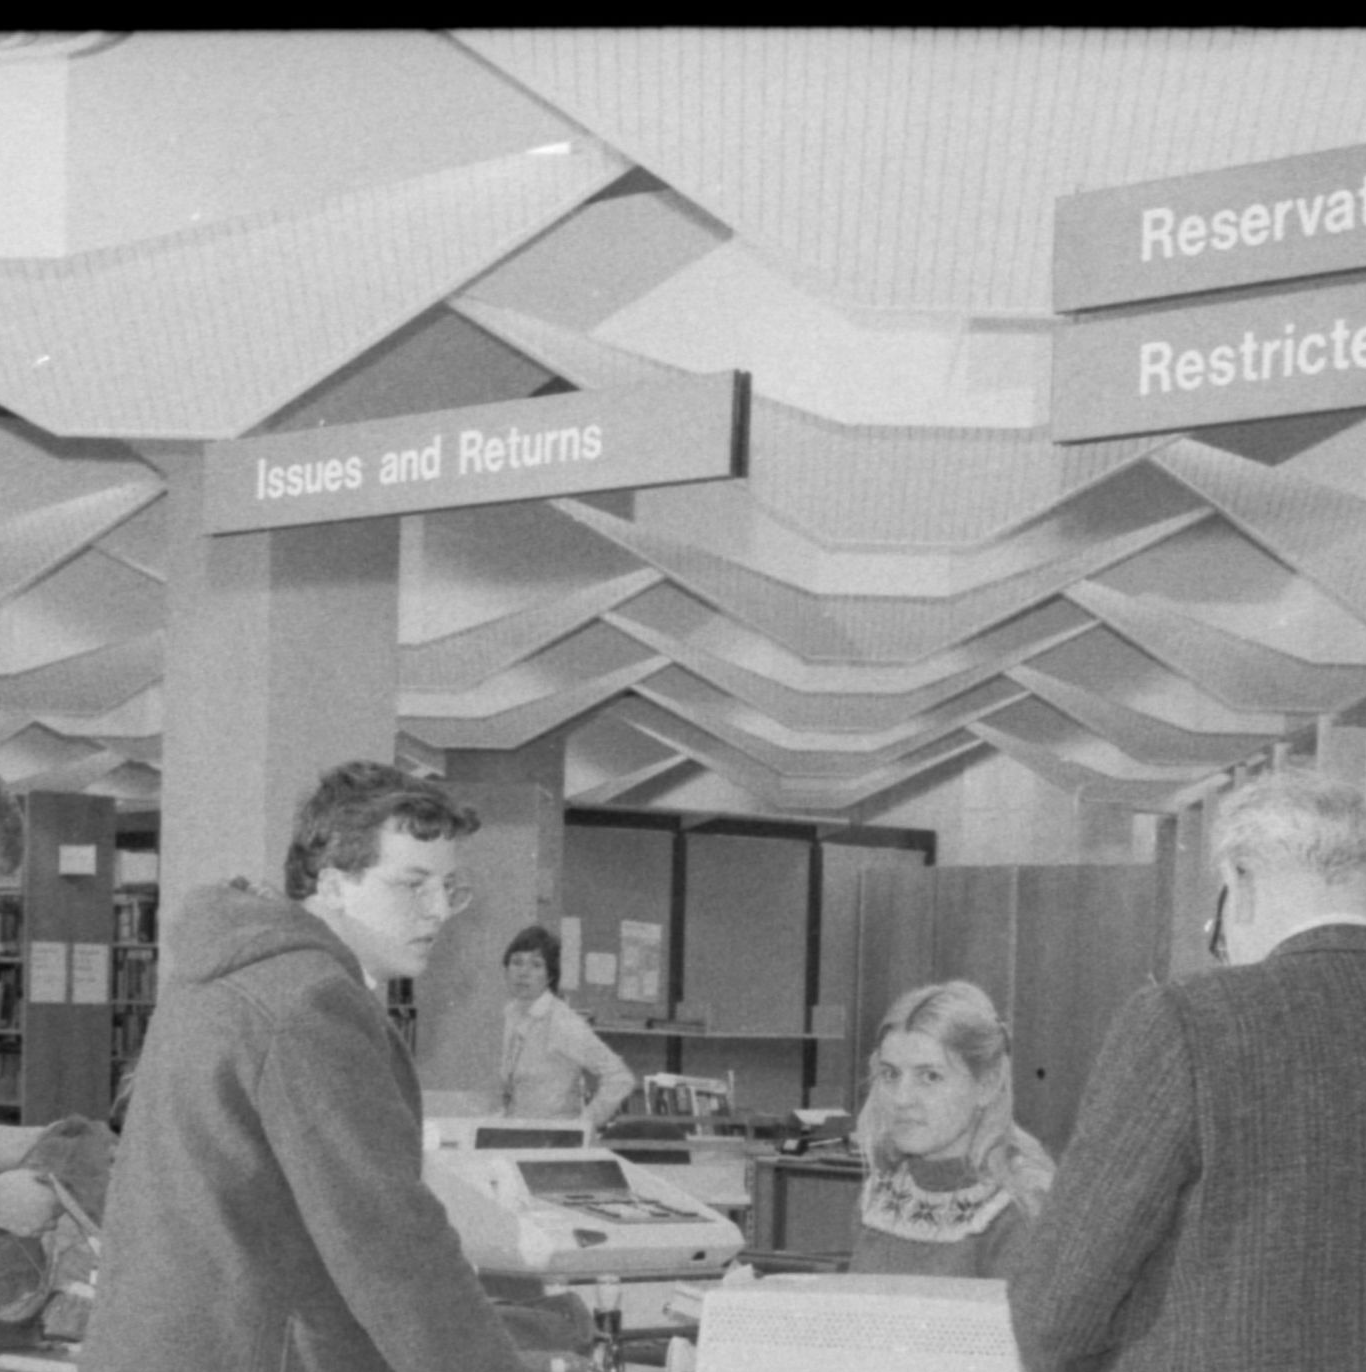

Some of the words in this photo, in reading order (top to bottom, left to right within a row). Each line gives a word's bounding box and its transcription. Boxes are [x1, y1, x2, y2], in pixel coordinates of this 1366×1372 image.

[256, 455, 363, 501] Issues
[378, 435, 442, 486] and
[459, 423, 603, 475] Returns
